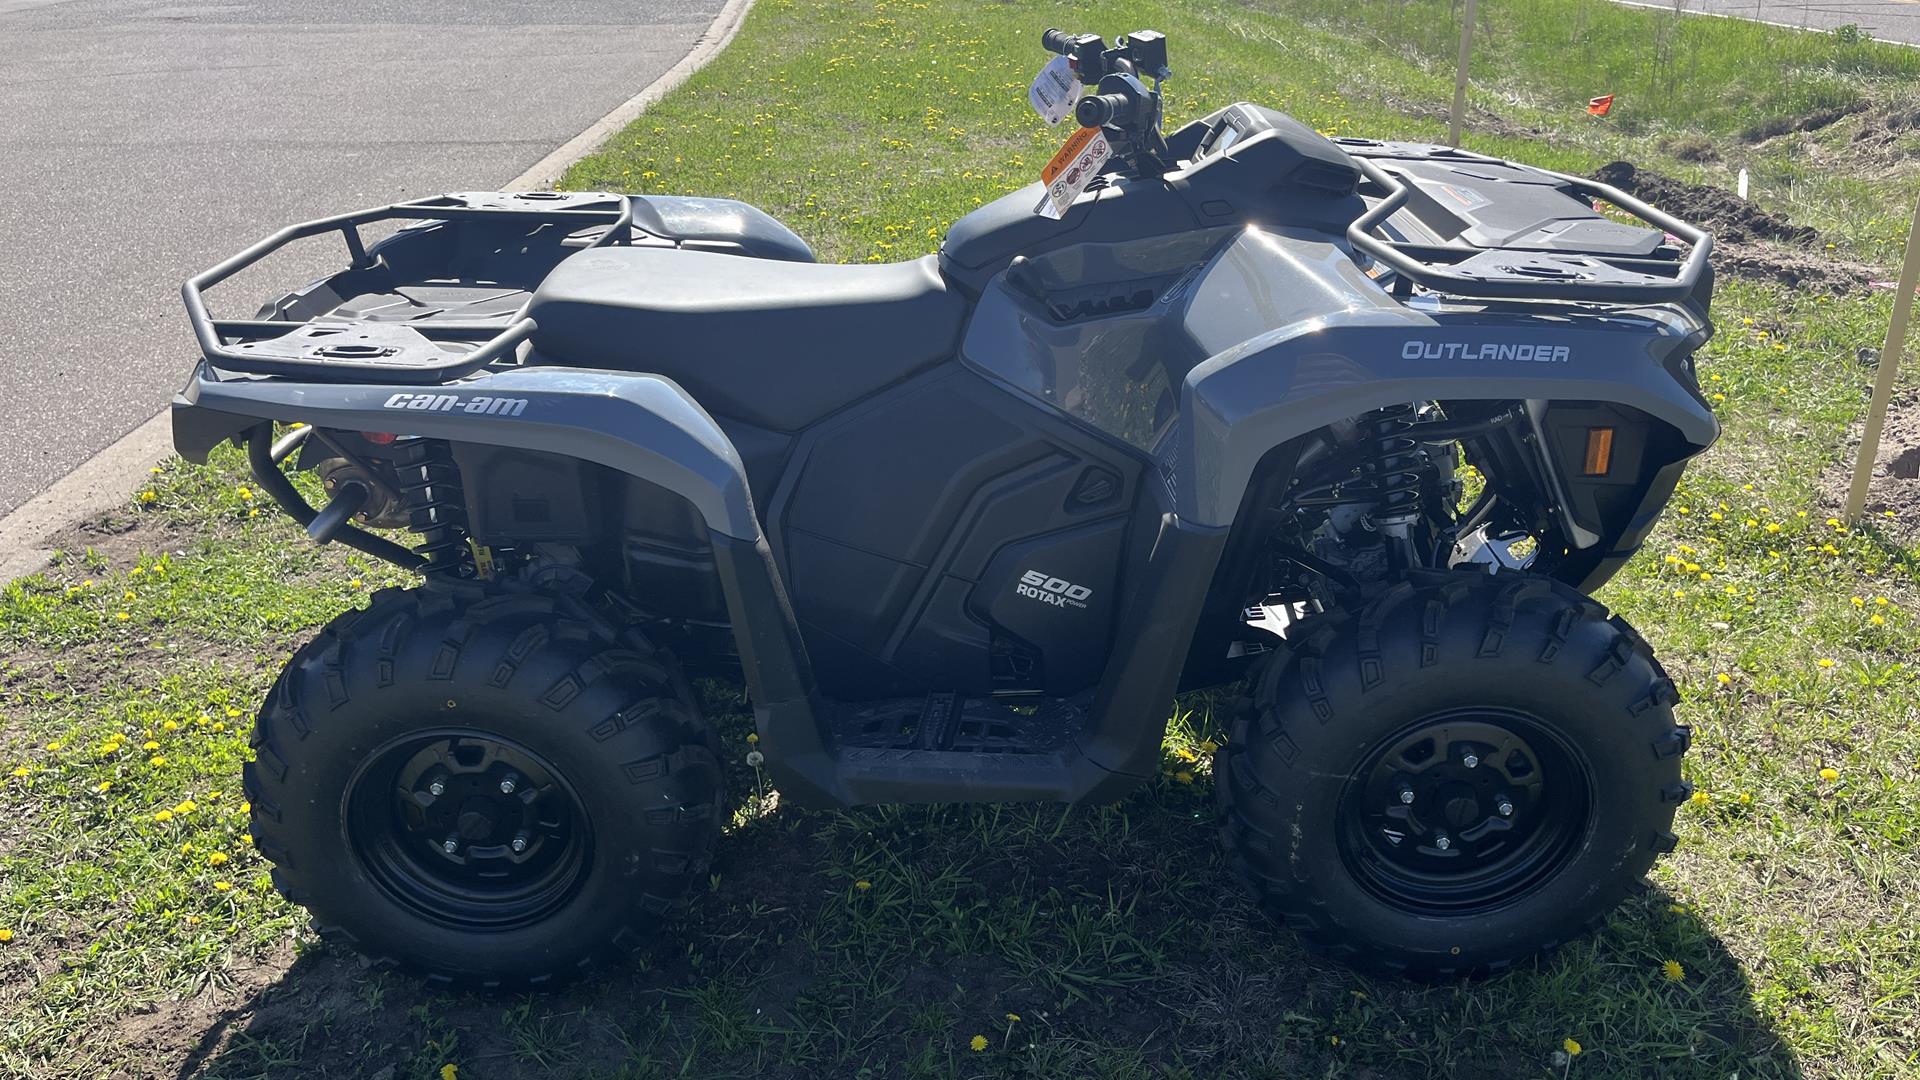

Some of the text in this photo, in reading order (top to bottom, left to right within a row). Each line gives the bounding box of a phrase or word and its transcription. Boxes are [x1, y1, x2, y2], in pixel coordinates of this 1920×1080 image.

[1401, 340, 1570, 362] OUTLANDER
[383, 393, 529, 417] can-am
[1016, 583, 1087, 609] ROTAX POWER
[1020, 569, 1093, 601] 500
